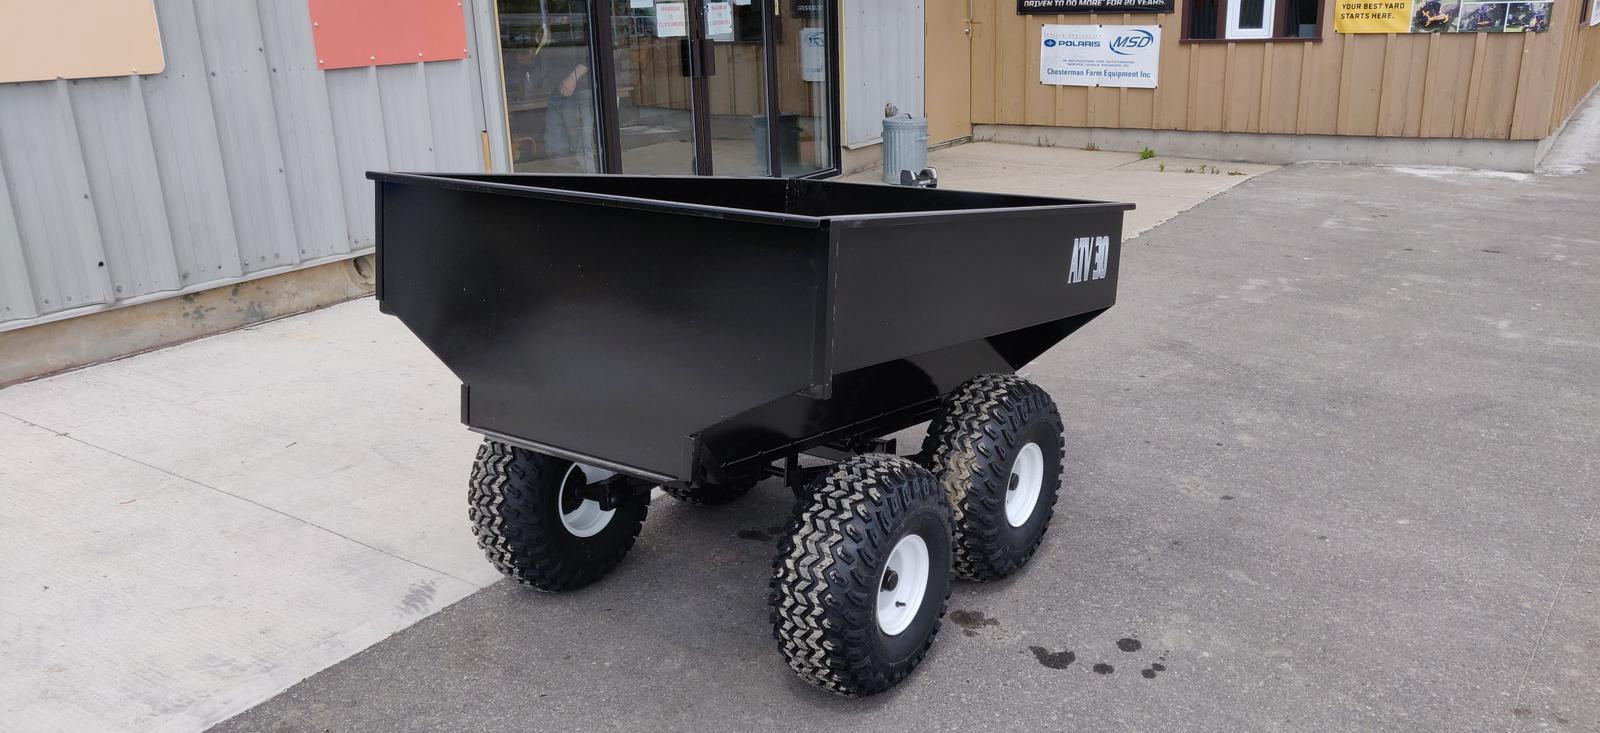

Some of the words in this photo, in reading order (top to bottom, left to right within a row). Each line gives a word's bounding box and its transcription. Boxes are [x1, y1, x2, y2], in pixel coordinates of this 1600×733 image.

[1058, 40, 1101, 48] POLARIS
[1112, 36, 1152, 48] MSD
[1046, 67, 1084, 76] Chesterman
[1086, 69, 1102, 77] Farm
[1104, 69, 1139, 78] Equipment
[1140, 70, 1151, 78] Inc
[1067, 237, 1094, 284] ATV
[1092, 235, 1110, 280] 30
